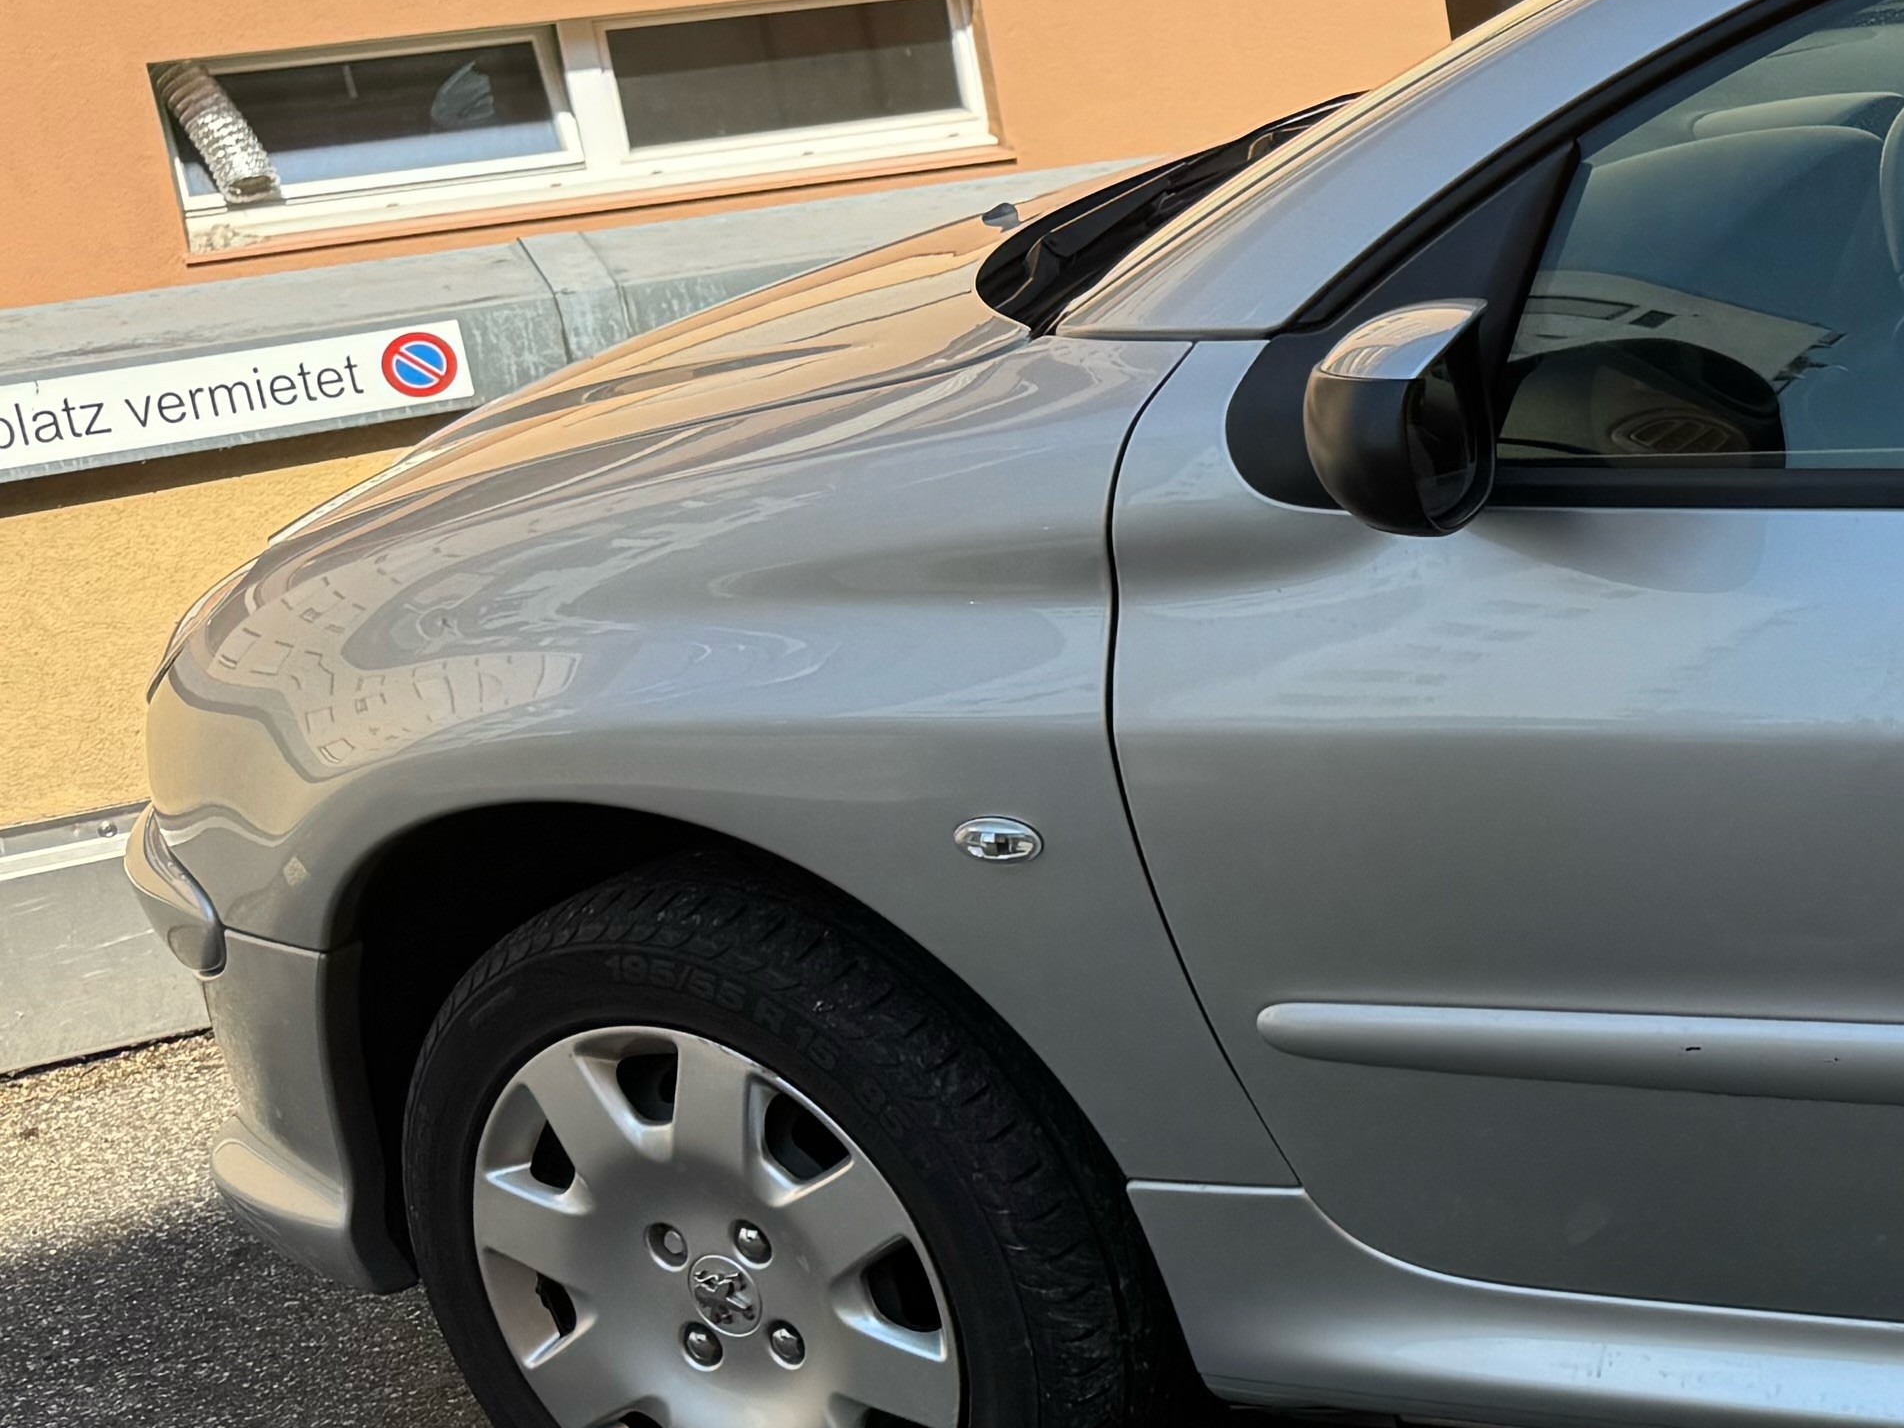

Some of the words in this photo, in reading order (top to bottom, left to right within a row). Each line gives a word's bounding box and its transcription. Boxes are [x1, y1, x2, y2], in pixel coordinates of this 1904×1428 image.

[124, 356, 365, 427] vermietet
[604, 954, 744, 1011] 195/55
[752, 998, 786, 1034] R
[796, 1025, 836, 1070] 15
